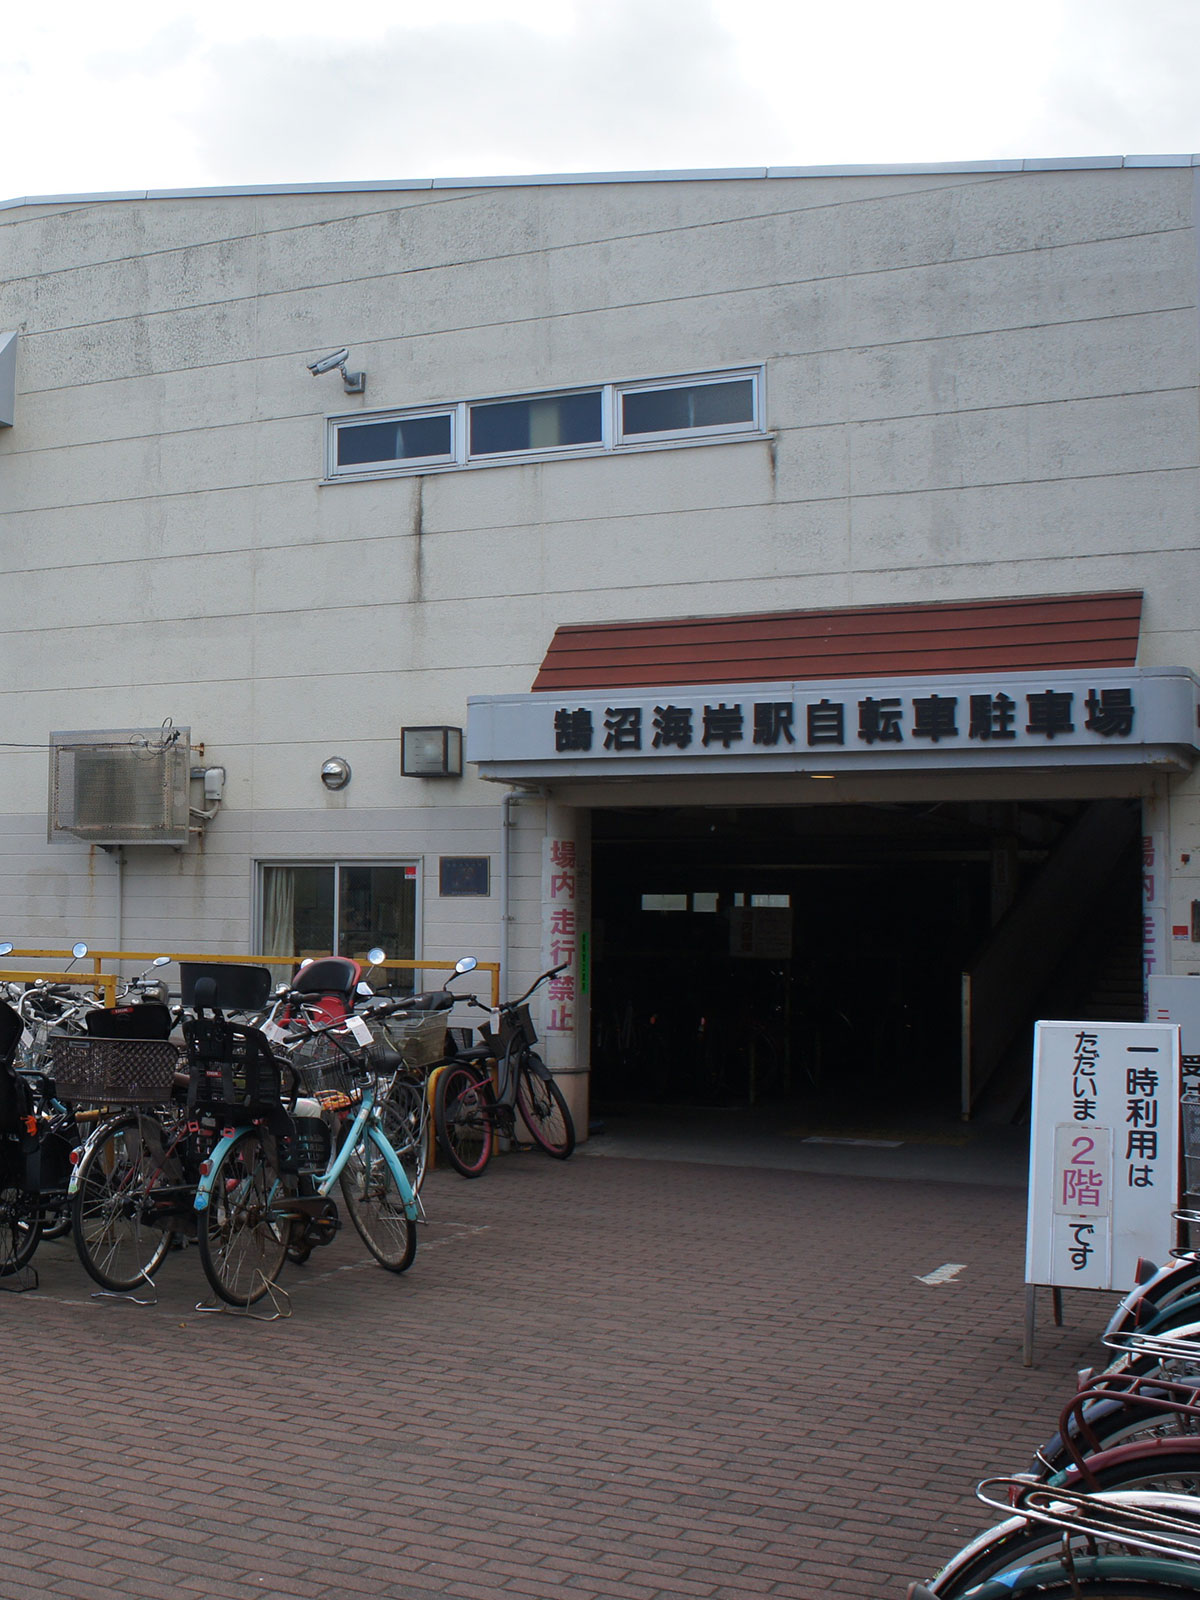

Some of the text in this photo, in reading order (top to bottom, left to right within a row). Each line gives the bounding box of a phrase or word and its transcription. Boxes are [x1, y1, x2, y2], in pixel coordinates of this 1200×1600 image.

[553, 688, 1135, 752] 鵠沼海岸駅自転車駐車場
[546, 840, 576, 1032] 場内走行禁止
[1125, 1046, 1159, 1188] 一時利用は
